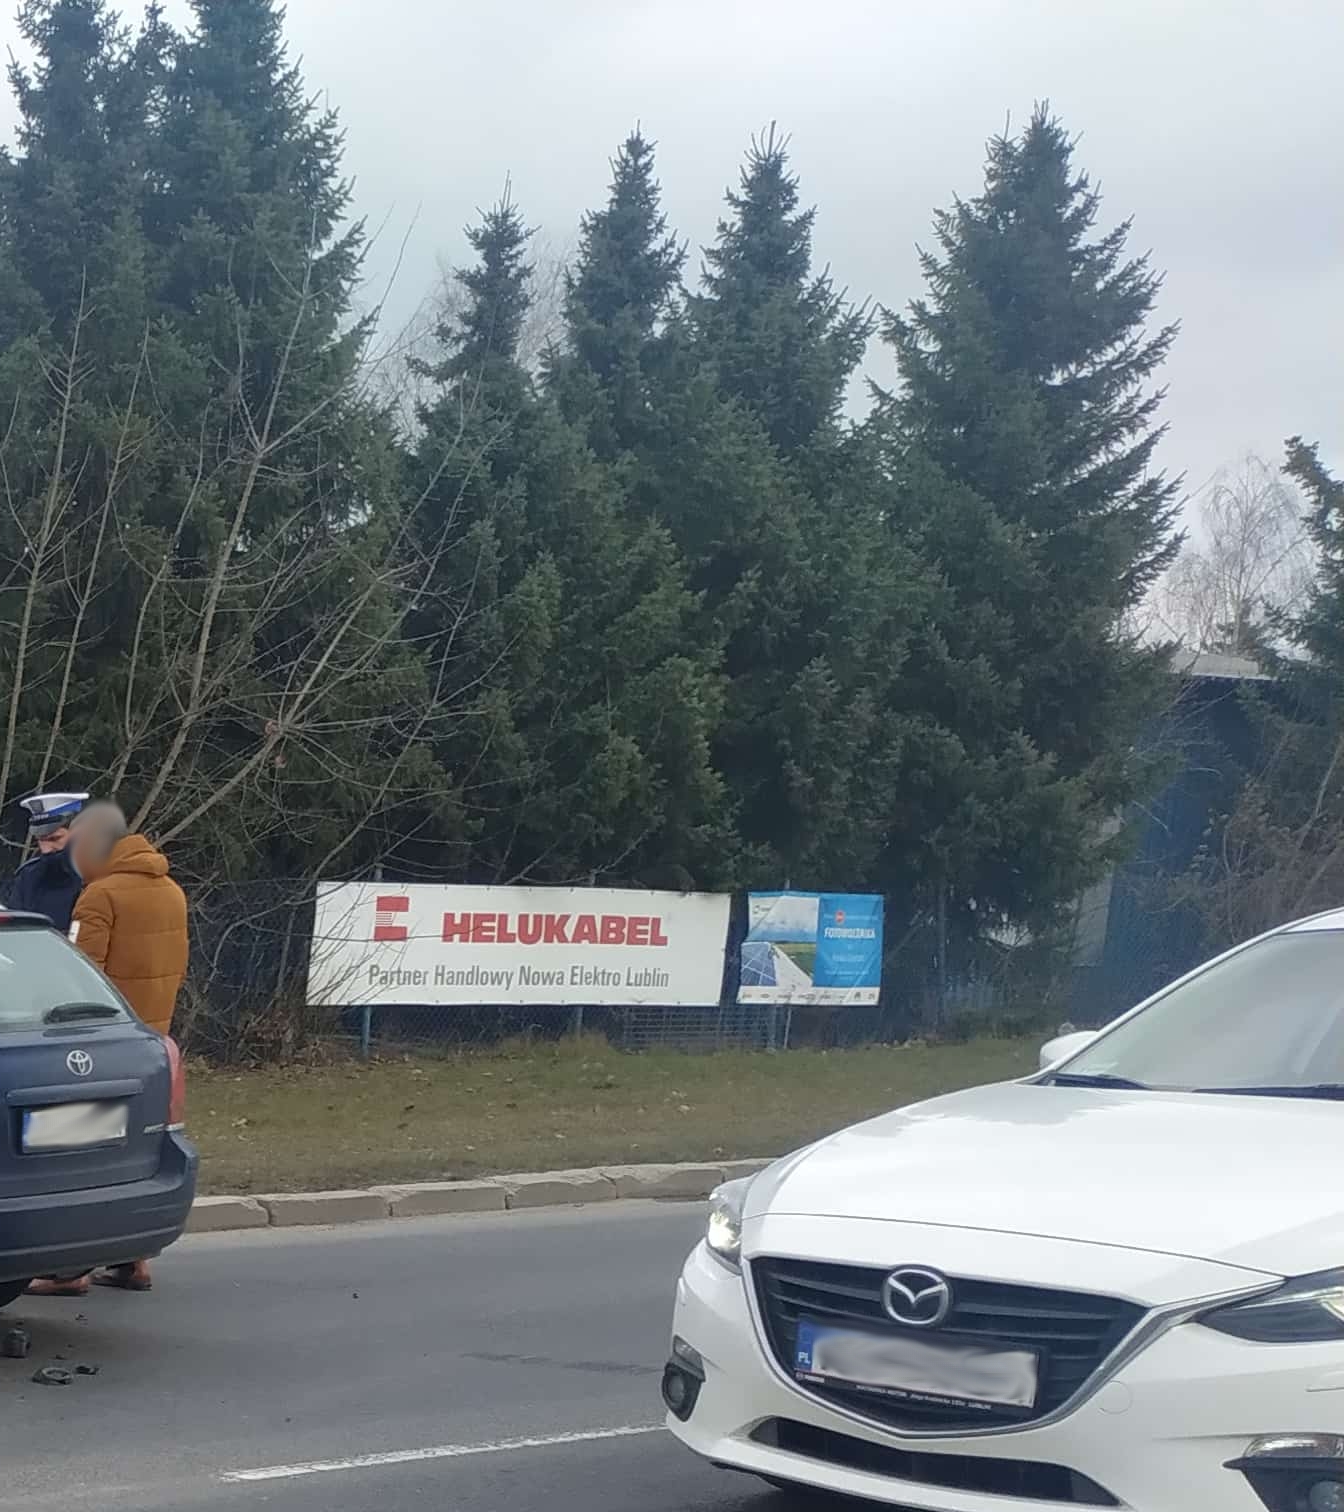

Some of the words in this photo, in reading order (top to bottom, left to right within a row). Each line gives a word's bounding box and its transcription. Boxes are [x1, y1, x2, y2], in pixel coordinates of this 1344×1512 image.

[441, 912, 668, 946] HELUKABEL
[368, 964, 430, 986] Partner
[434, 964, 514, 991] Handlowy
[518, 965, 564, 986] Nowa
[570, 965, 621, 987] Elektro
[626, 966, 670, 988] Lublin
